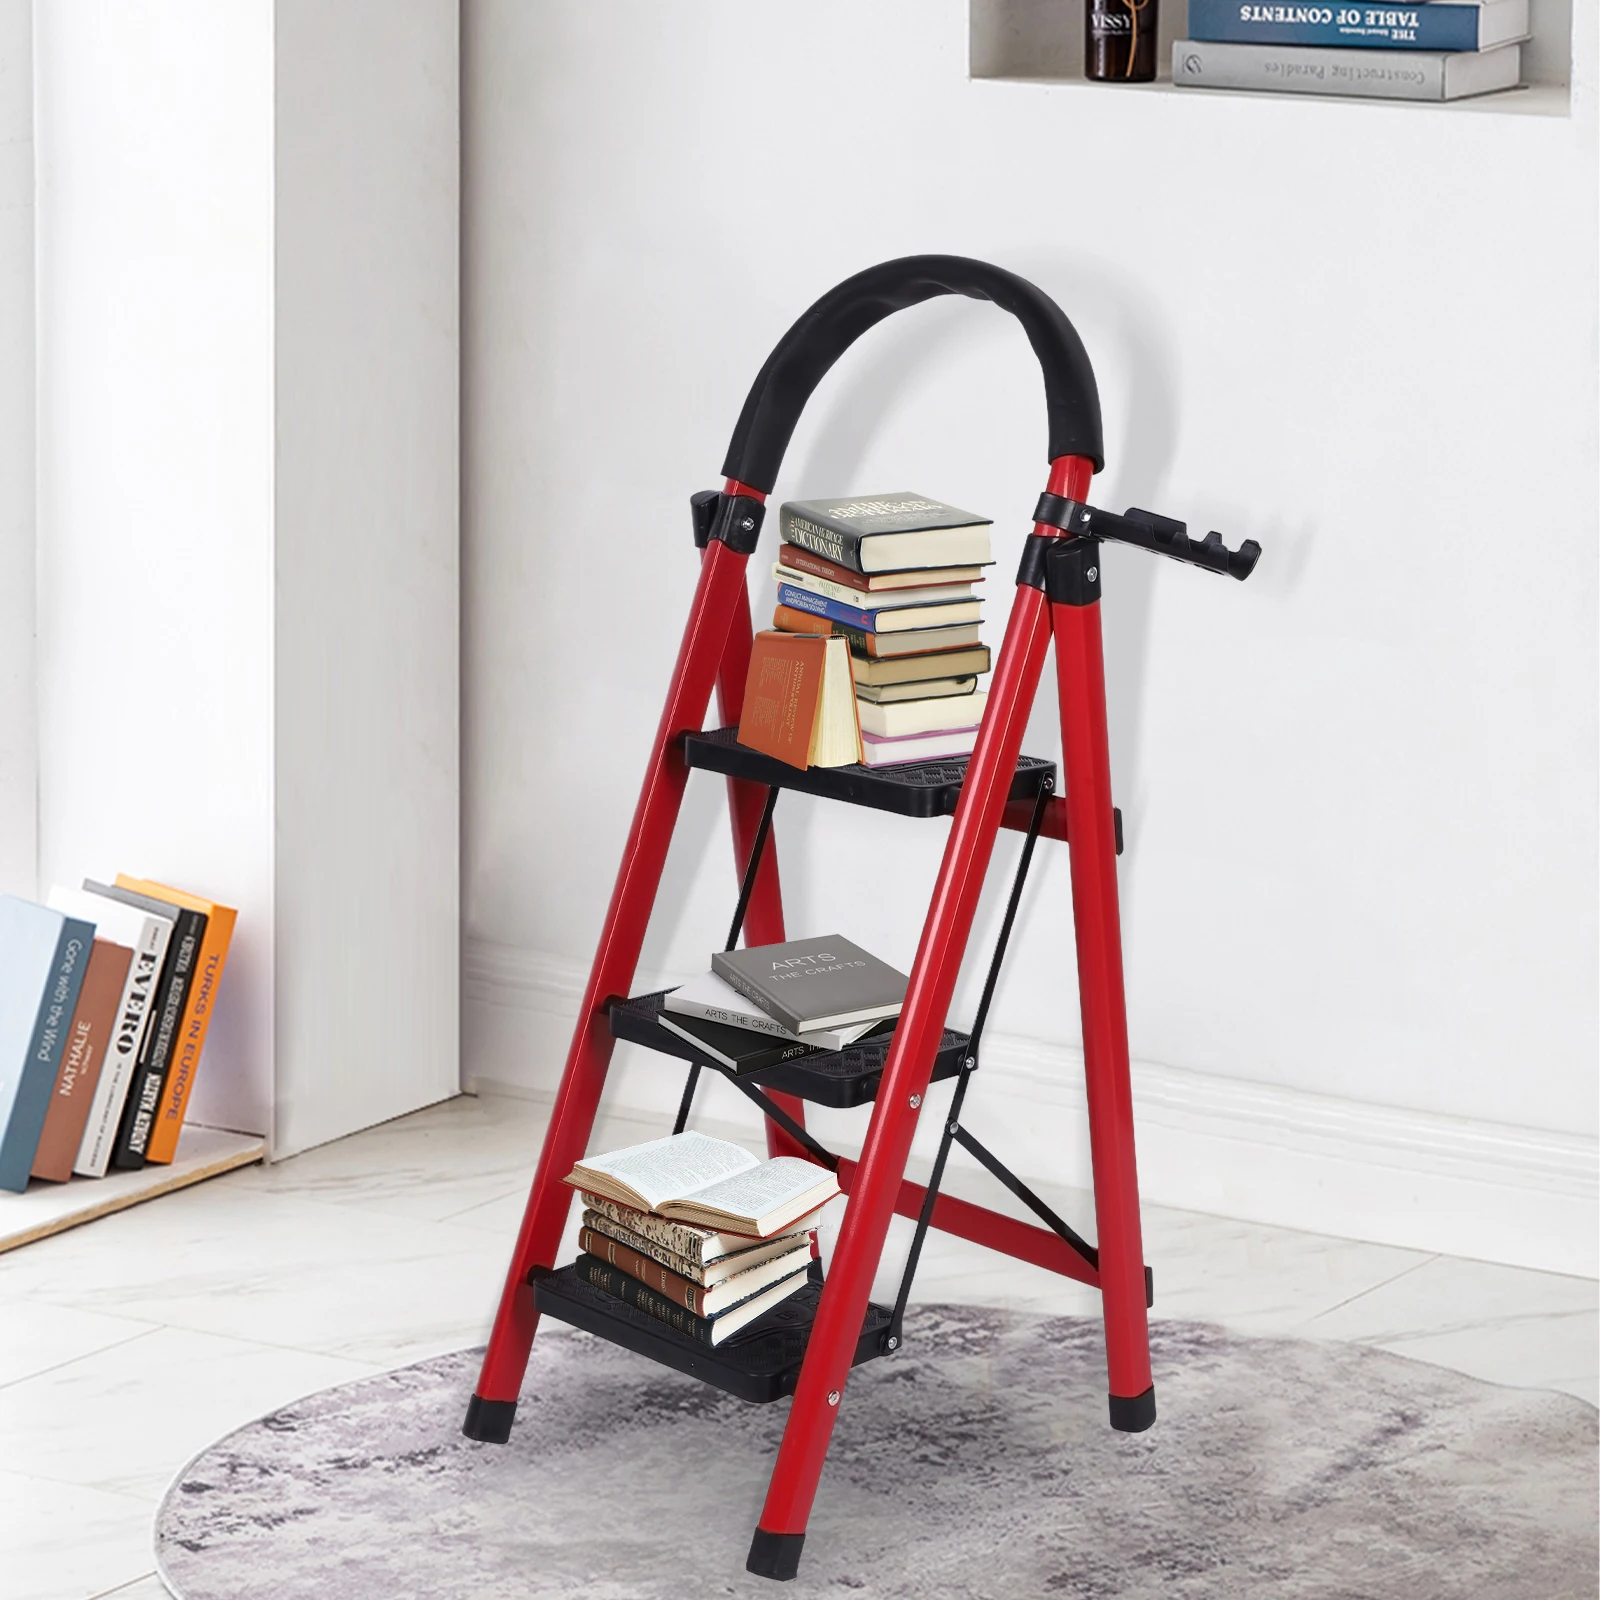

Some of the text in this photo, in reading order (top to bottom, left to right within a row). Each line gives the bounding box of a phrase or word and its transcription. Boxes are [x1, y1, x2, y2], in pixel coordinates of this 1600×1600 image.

[1240, 6, 1419, 27] TABLE OF CONTENTS
[1391, 30, 1417, 41] THE
[1264, 62, 1425, 85] Constructing Paradies
[795, 527, 844, 562] DICTIONARY
[768, 960, 866, 982] THE CRAFTS
[772, 953, 836, 970] ARTS
[37, 938, 83, 1062] Gone with the Wind
[729, 972, 770, 1011] ARTS THE CRAFTS
[705, 1008, 787, 1035] ARTS THE CRAFTS
[166, 953, 221, 1121] TURKS IN EUROPE
[60, 1020, 91, 1096] NATHALIE
[782, 1045, 805, 1060] ARTS
